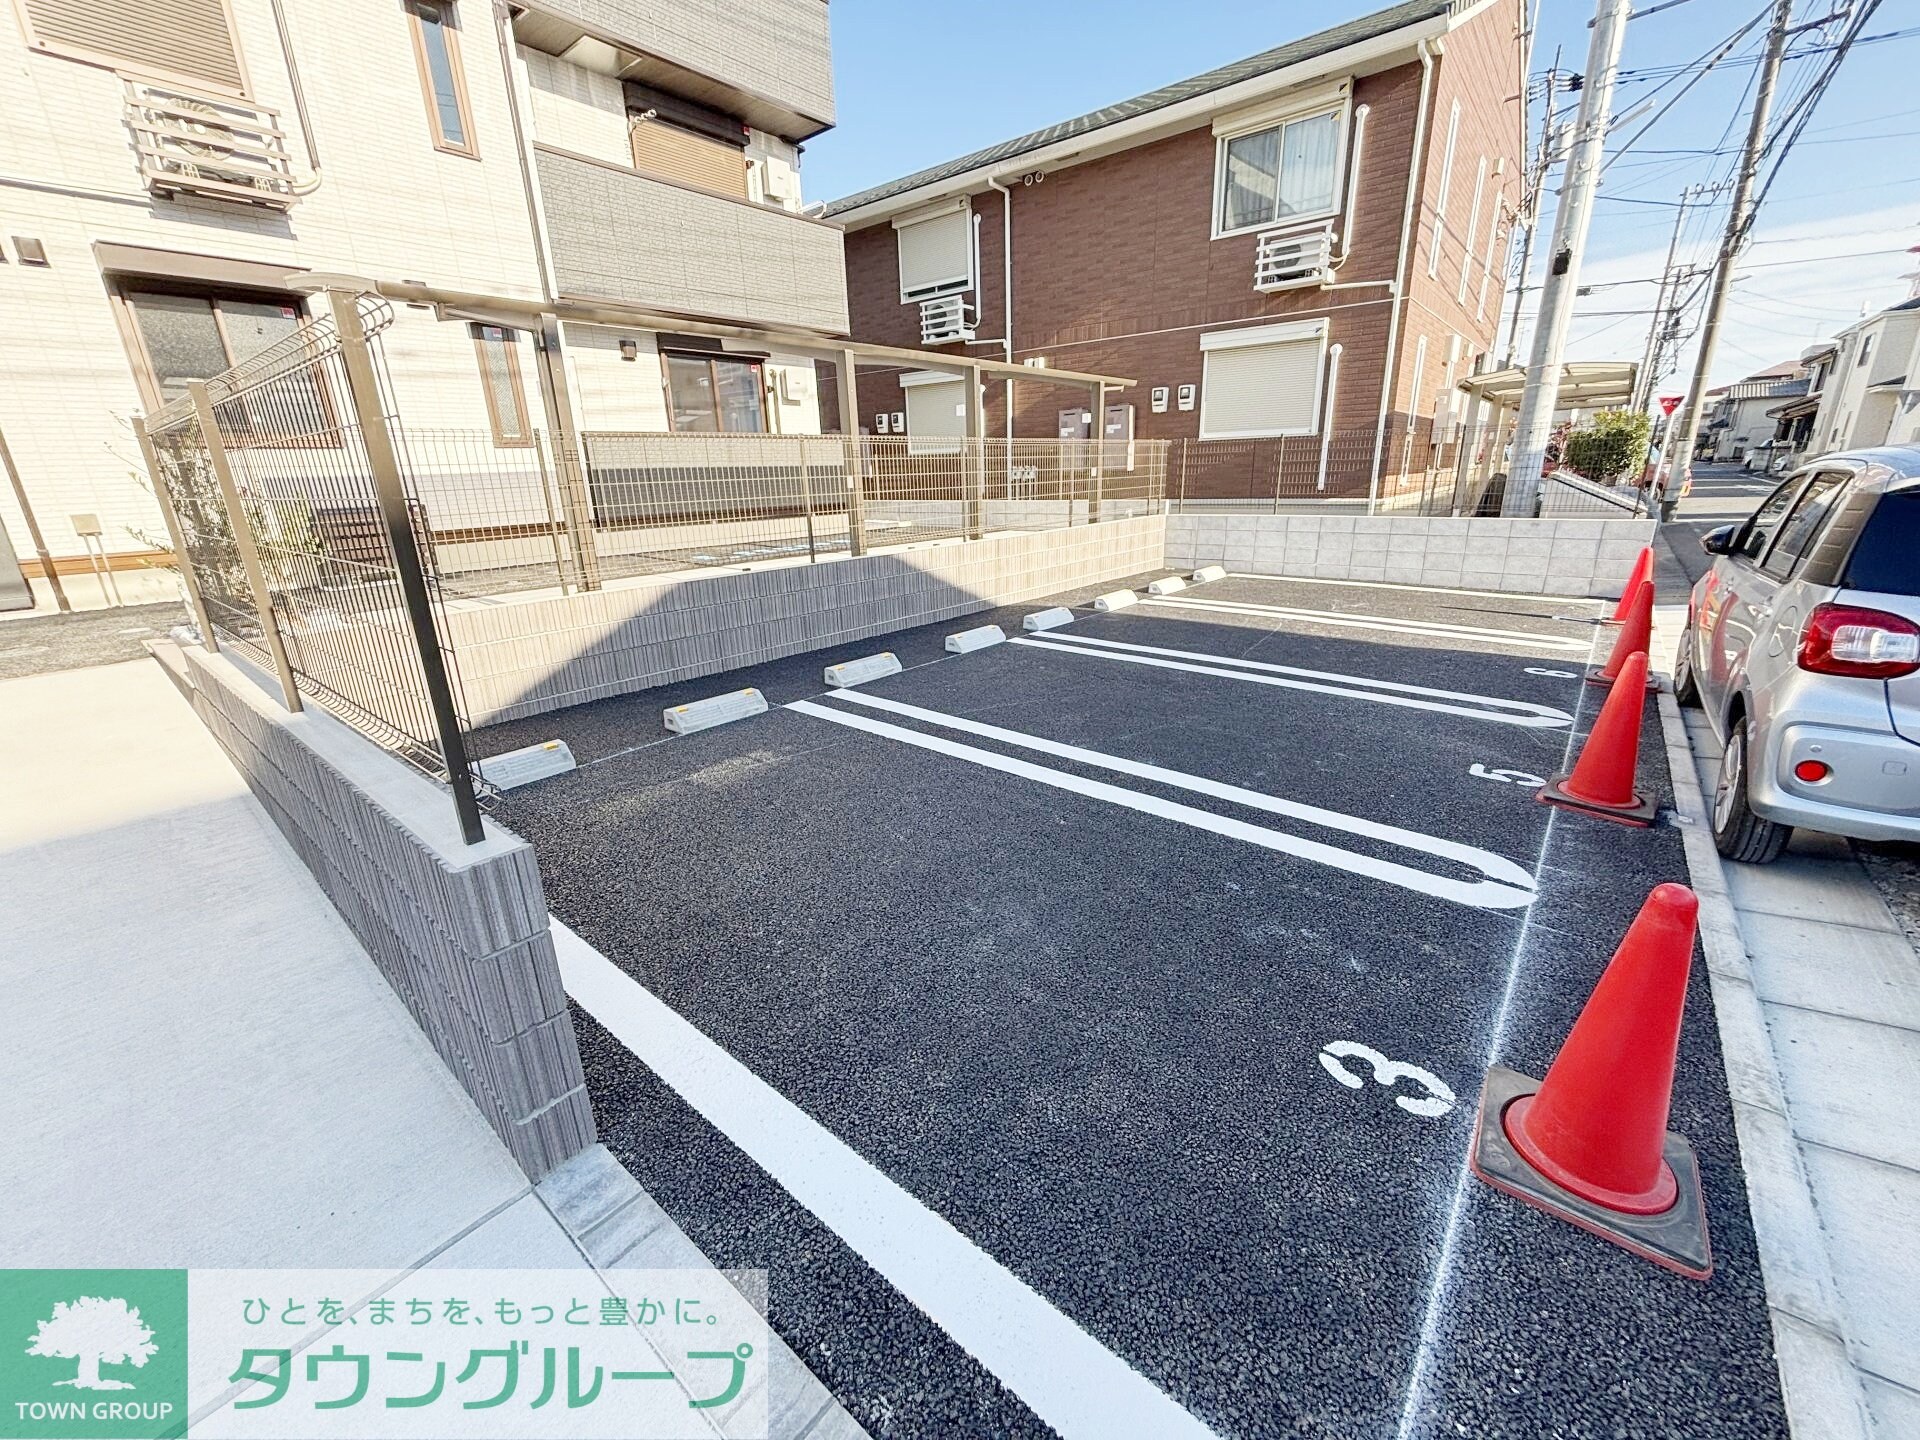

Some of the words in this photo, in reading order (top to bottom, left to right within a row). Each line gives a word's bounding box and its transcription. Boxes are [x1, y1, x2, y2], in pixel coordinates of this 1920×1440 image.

[1523, 667, 1578, 679] 6
[1469, 763, 1547, 787] 5
[1318, 1040, 1457, 1118] 3
